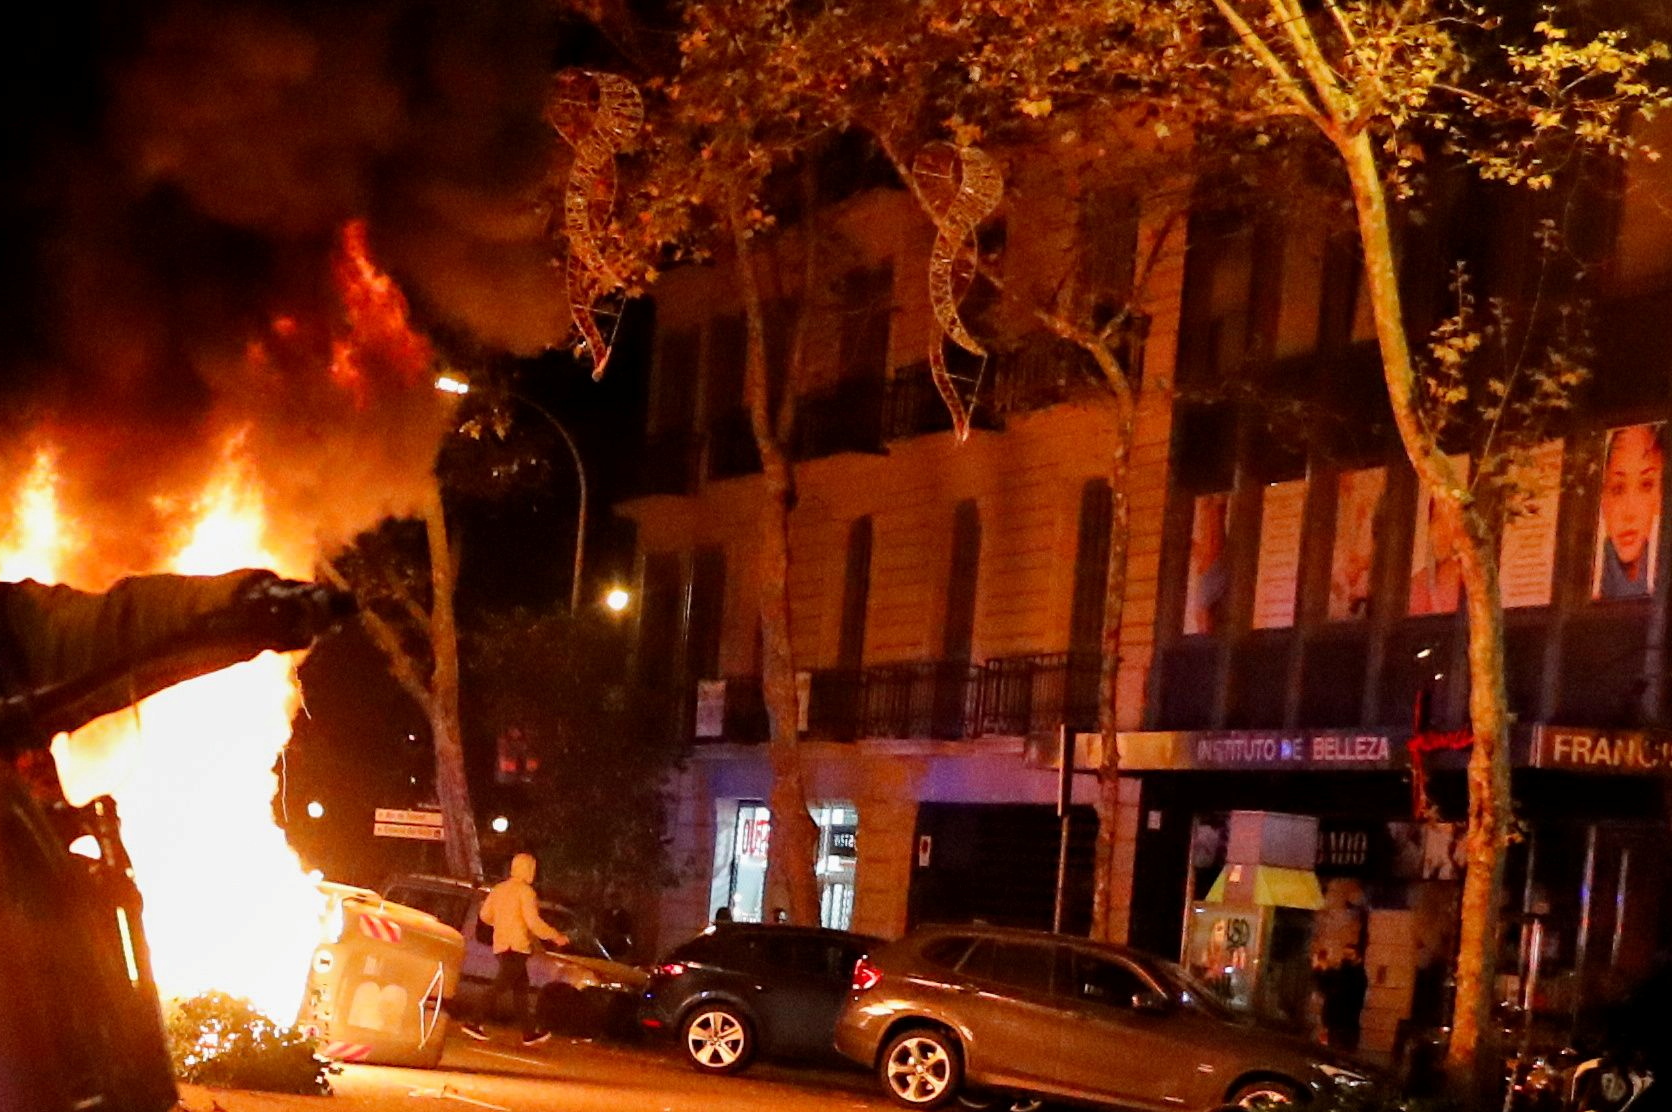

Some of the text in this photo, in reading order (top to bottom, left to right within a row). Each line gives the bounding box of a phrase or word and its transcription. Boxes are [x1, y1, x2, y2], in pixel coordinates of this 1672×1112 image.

[1197, 736, 1389, 761] INSTITUTO DE BELLEZA
